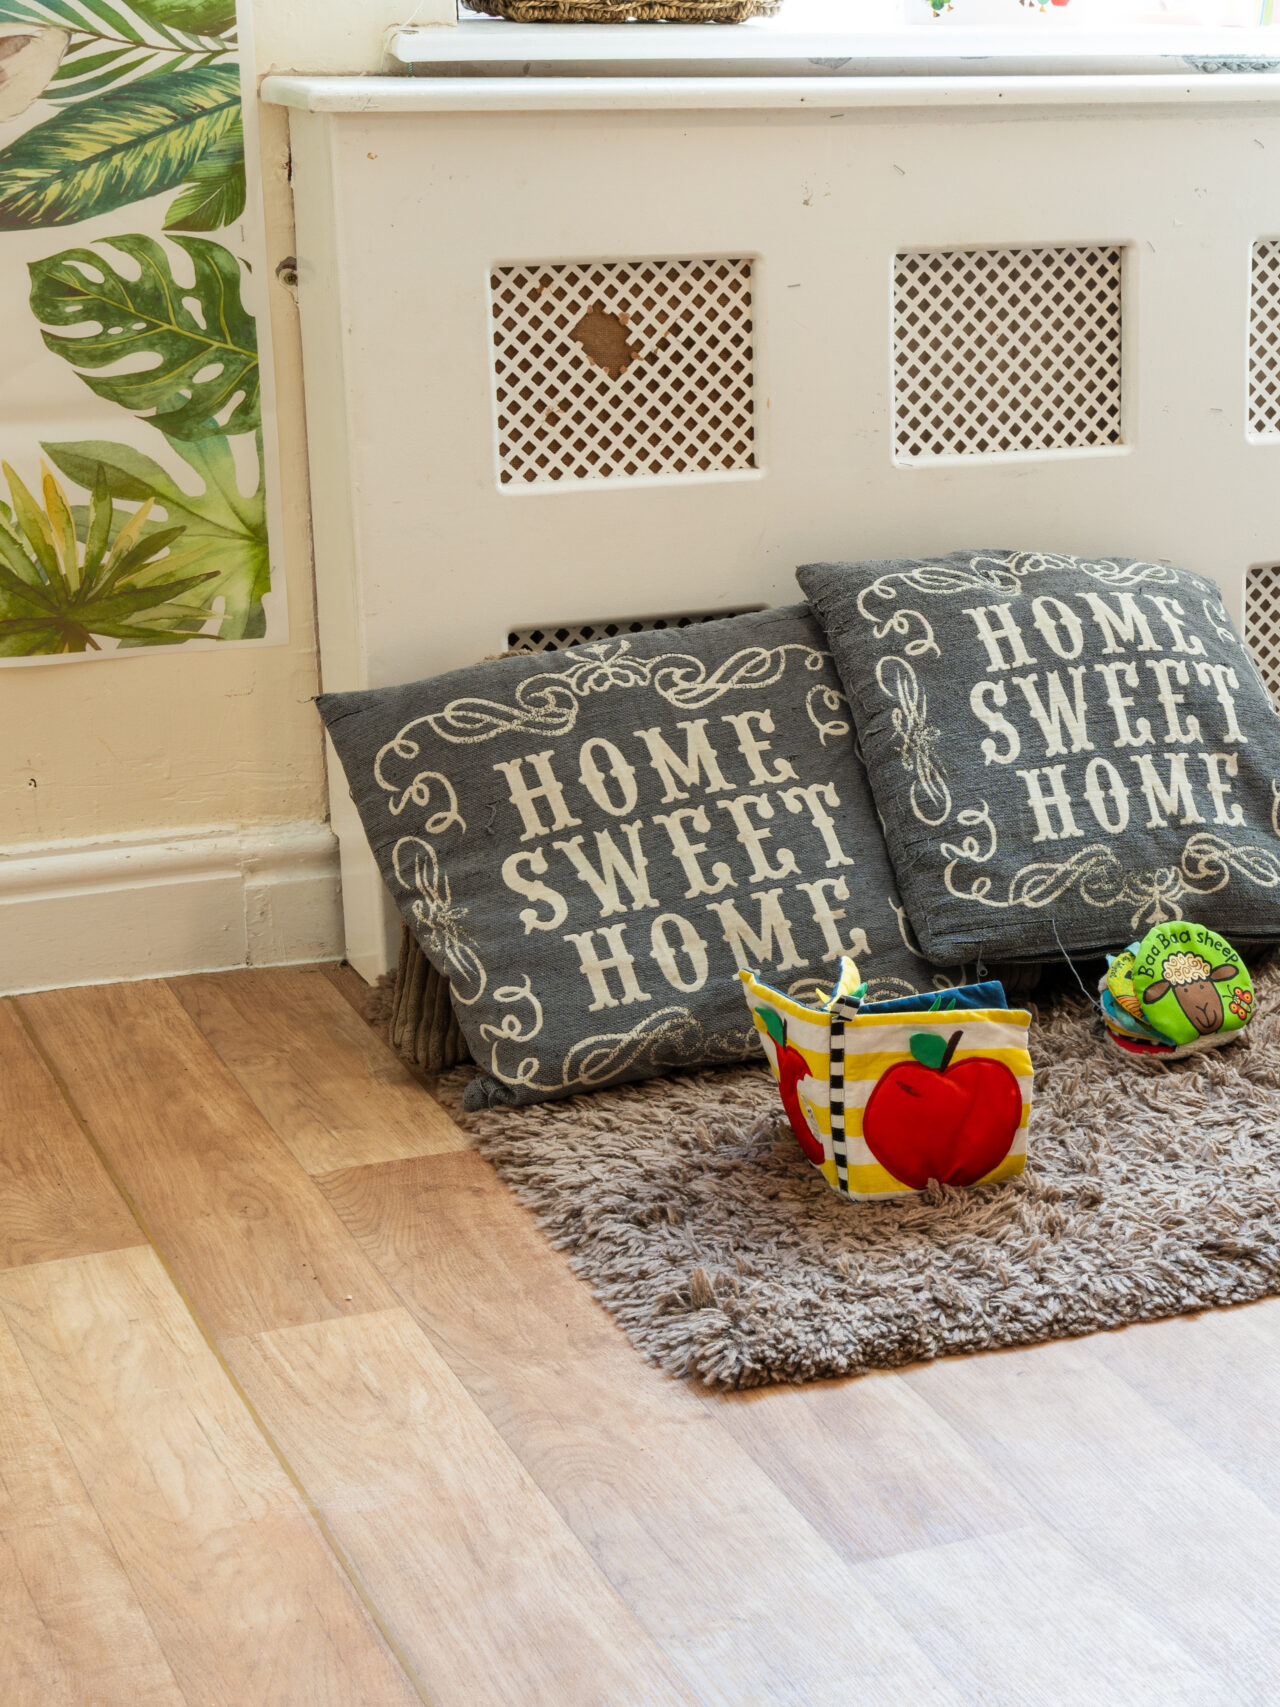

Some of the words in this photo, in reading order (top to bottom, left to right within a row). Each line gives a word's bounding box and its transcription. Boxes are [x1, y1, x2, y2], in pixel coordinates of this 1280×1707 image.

[962, 592, 1209, 673] HOME
[969, 659, 1249, 766] SWEET
[493, 709, 800, 842] HOME
[1016, 752, 1248, 843] HOME
[502, 781, 855, 935] SWEET
[563, 875, 872, 1013] HOME
[1138, 947, 1161, 979] Baa
[1156, 929, 1191, 950] Baa
[1197, 930, 1239, 963] sheep
